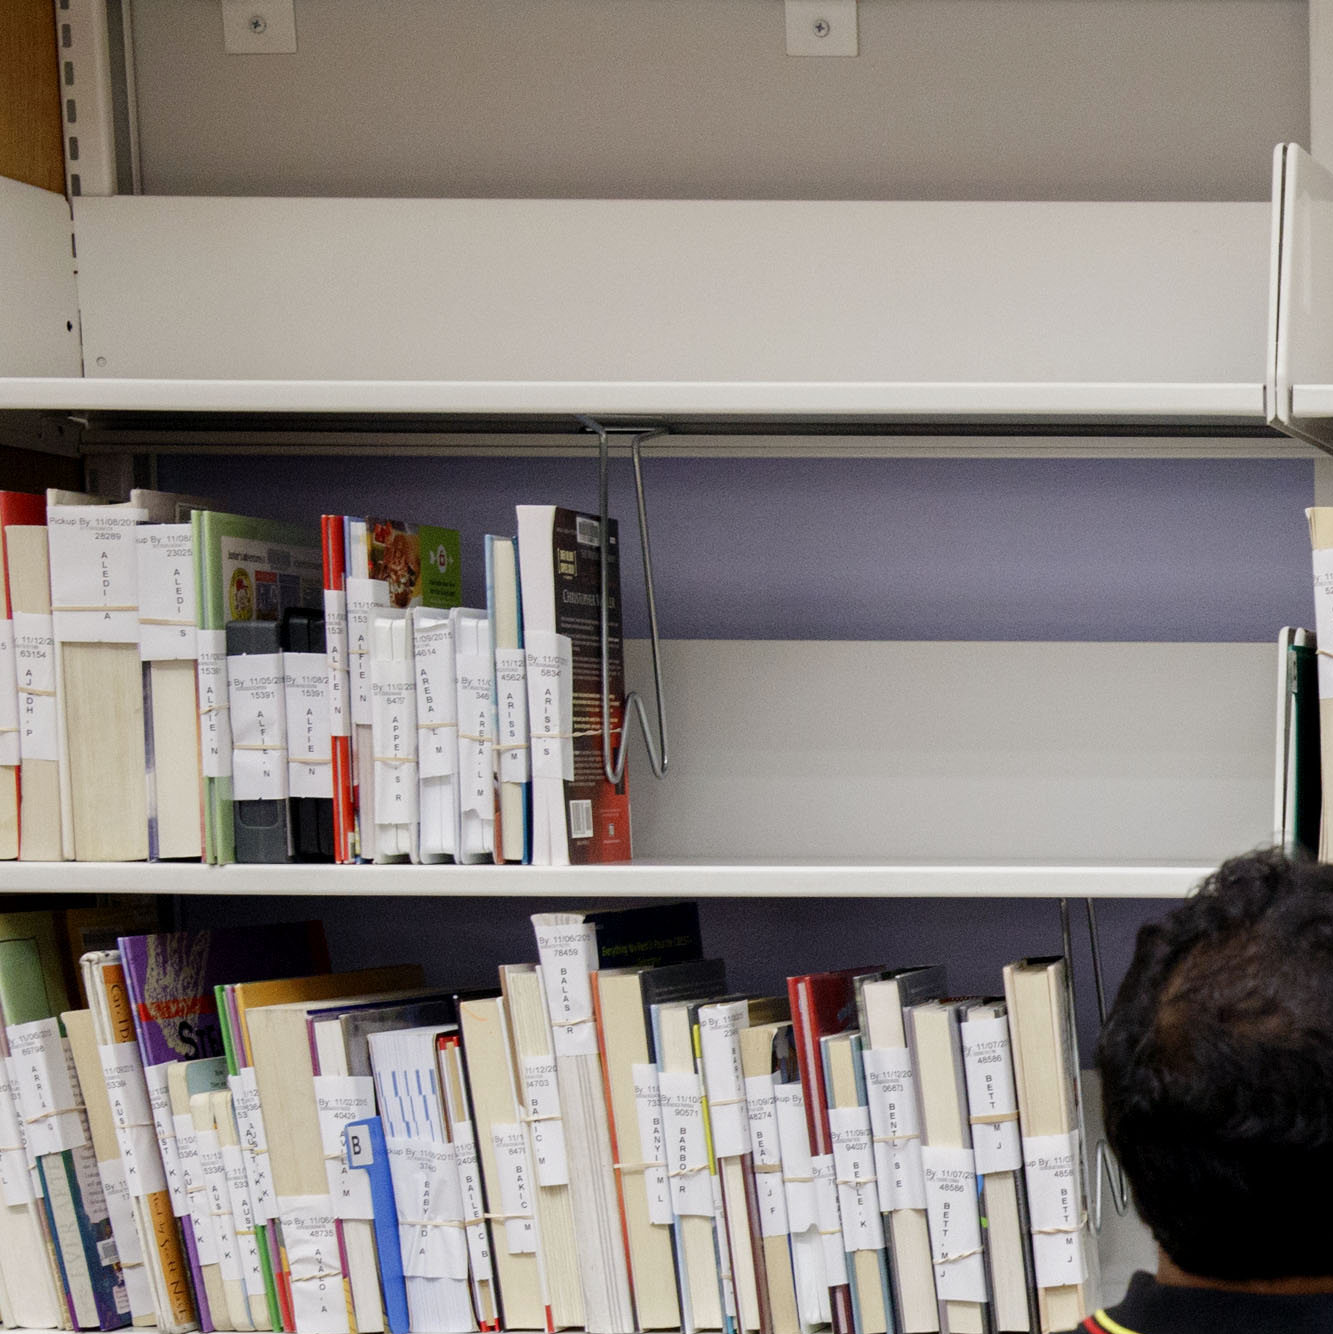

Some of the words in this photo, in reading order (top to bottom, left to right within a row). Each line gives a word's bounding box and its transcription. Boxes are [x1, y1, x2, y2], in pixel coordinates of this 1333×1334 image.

[978, 1055, 1002, 1064] 48586
[352, 1136, 361, 1155] B
[939, 1184, 964, 1192] 48586
